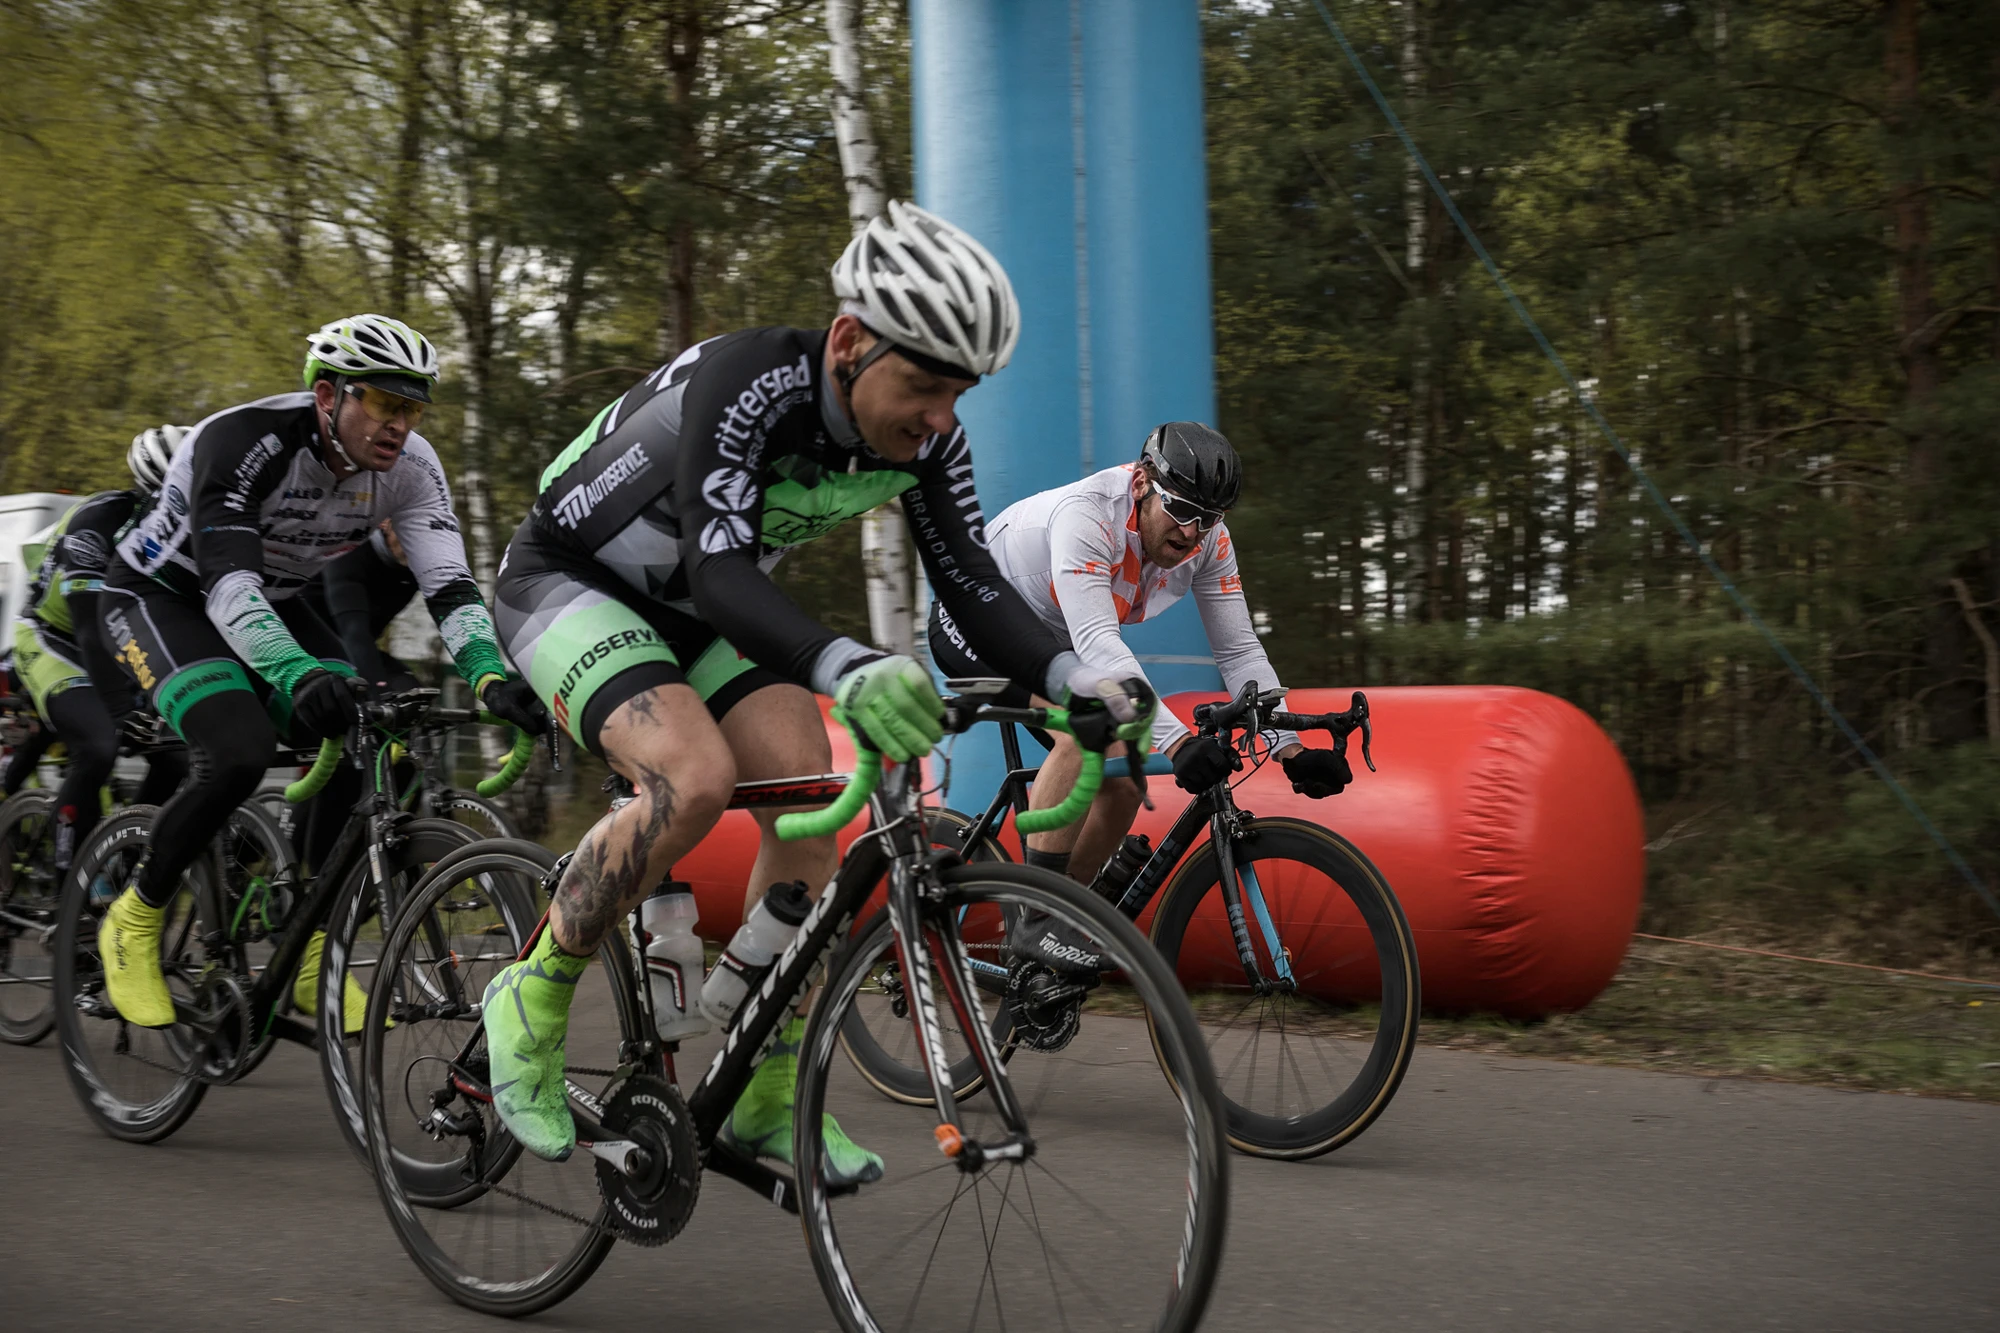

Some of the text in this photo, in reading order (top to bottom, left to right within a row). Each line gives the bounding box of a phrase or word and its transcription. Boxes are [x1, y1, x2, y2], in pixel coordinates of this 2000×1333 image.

[585, 442, 649, 508] AUTOSERVICE
[1228, 903, 1257, 965] RITTE
[631, 1094, 677, 1126] ROTOR
[614, 1197, 658, 1228] ROTOR
